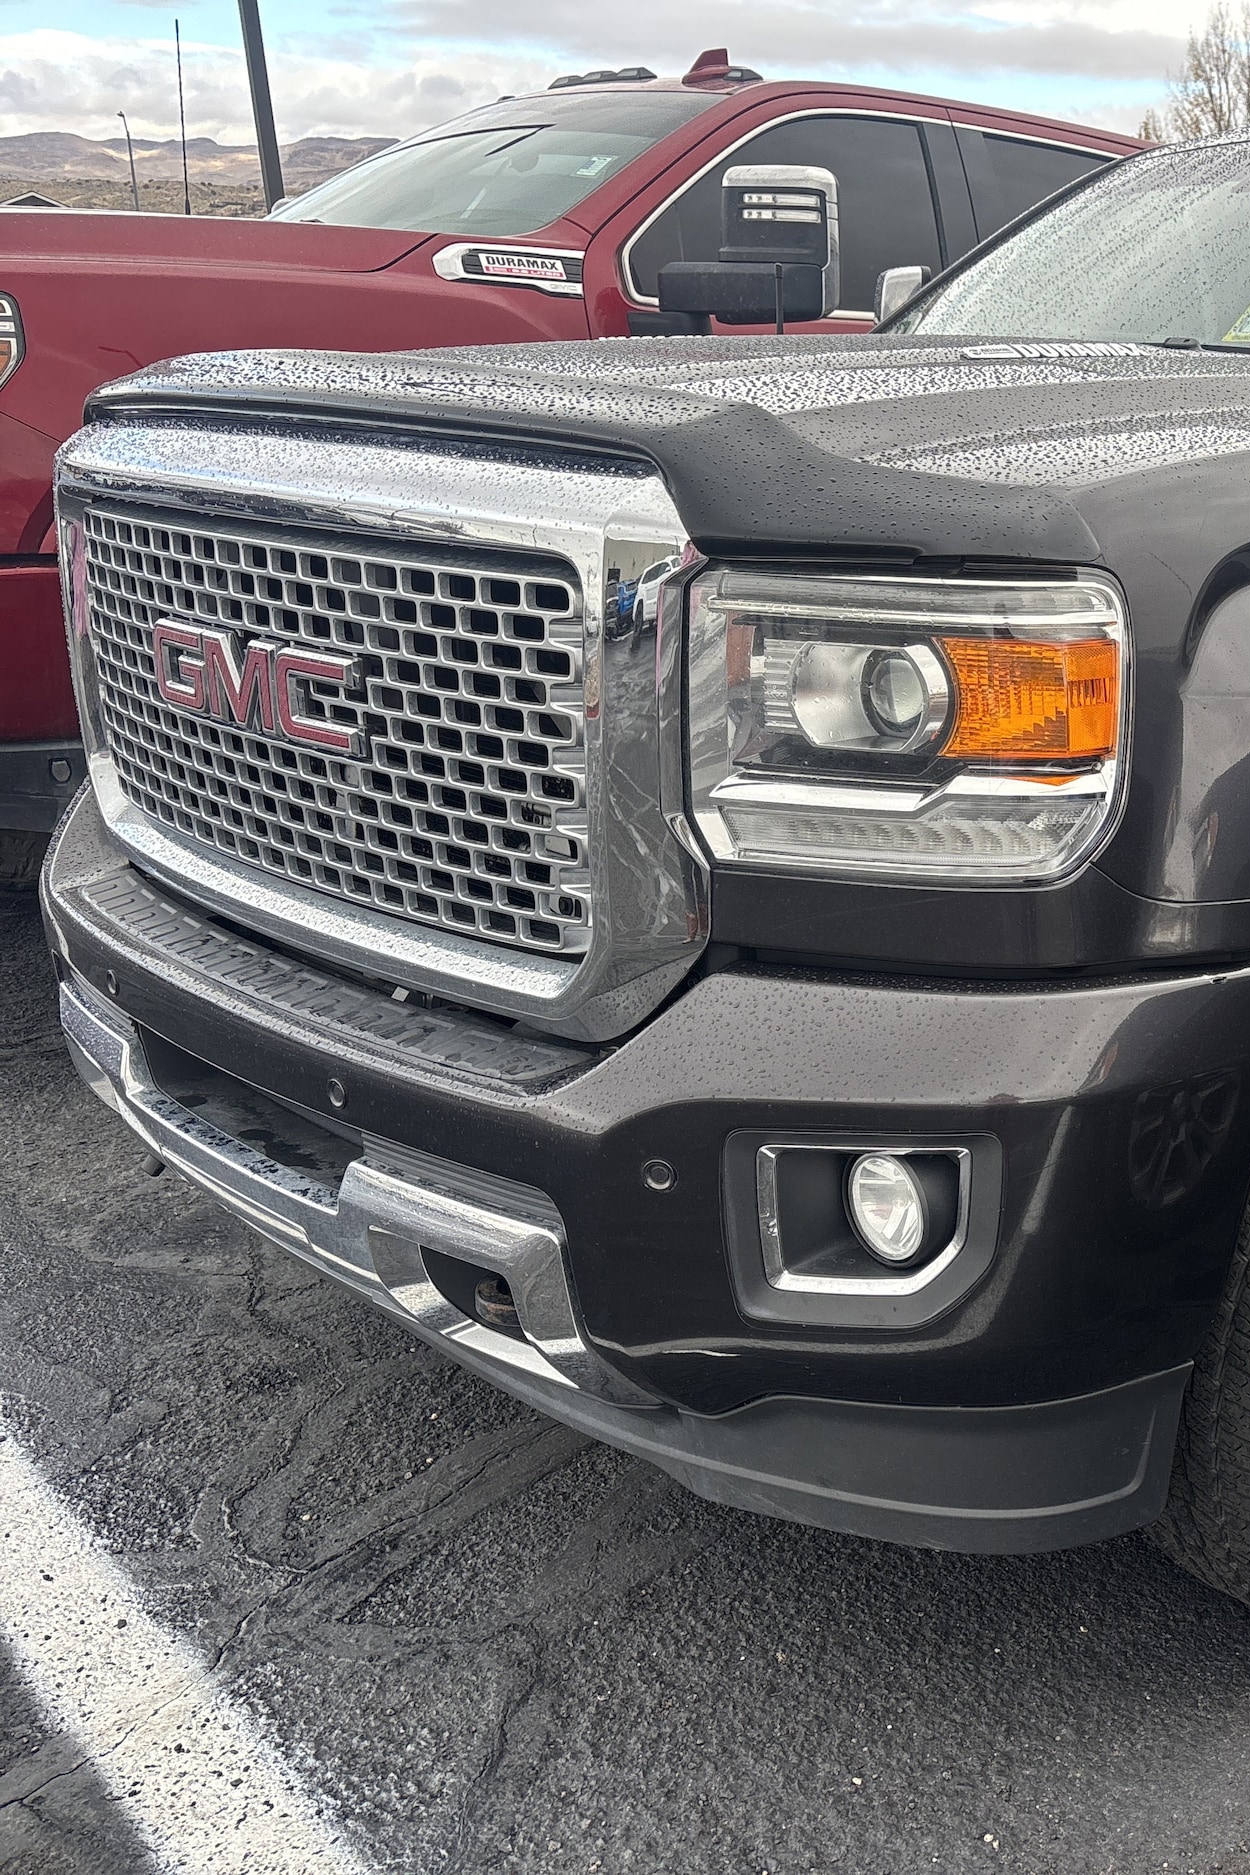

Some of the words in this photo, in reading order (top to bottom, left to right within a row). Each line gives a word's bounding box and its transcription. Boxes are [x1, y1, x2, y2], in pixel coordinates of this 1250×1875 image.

[485, 255, 559, 271] DURAMAX
[1014, 343, 1150, 358] DURAMAX
[154, 617, 362, 757] GMC
